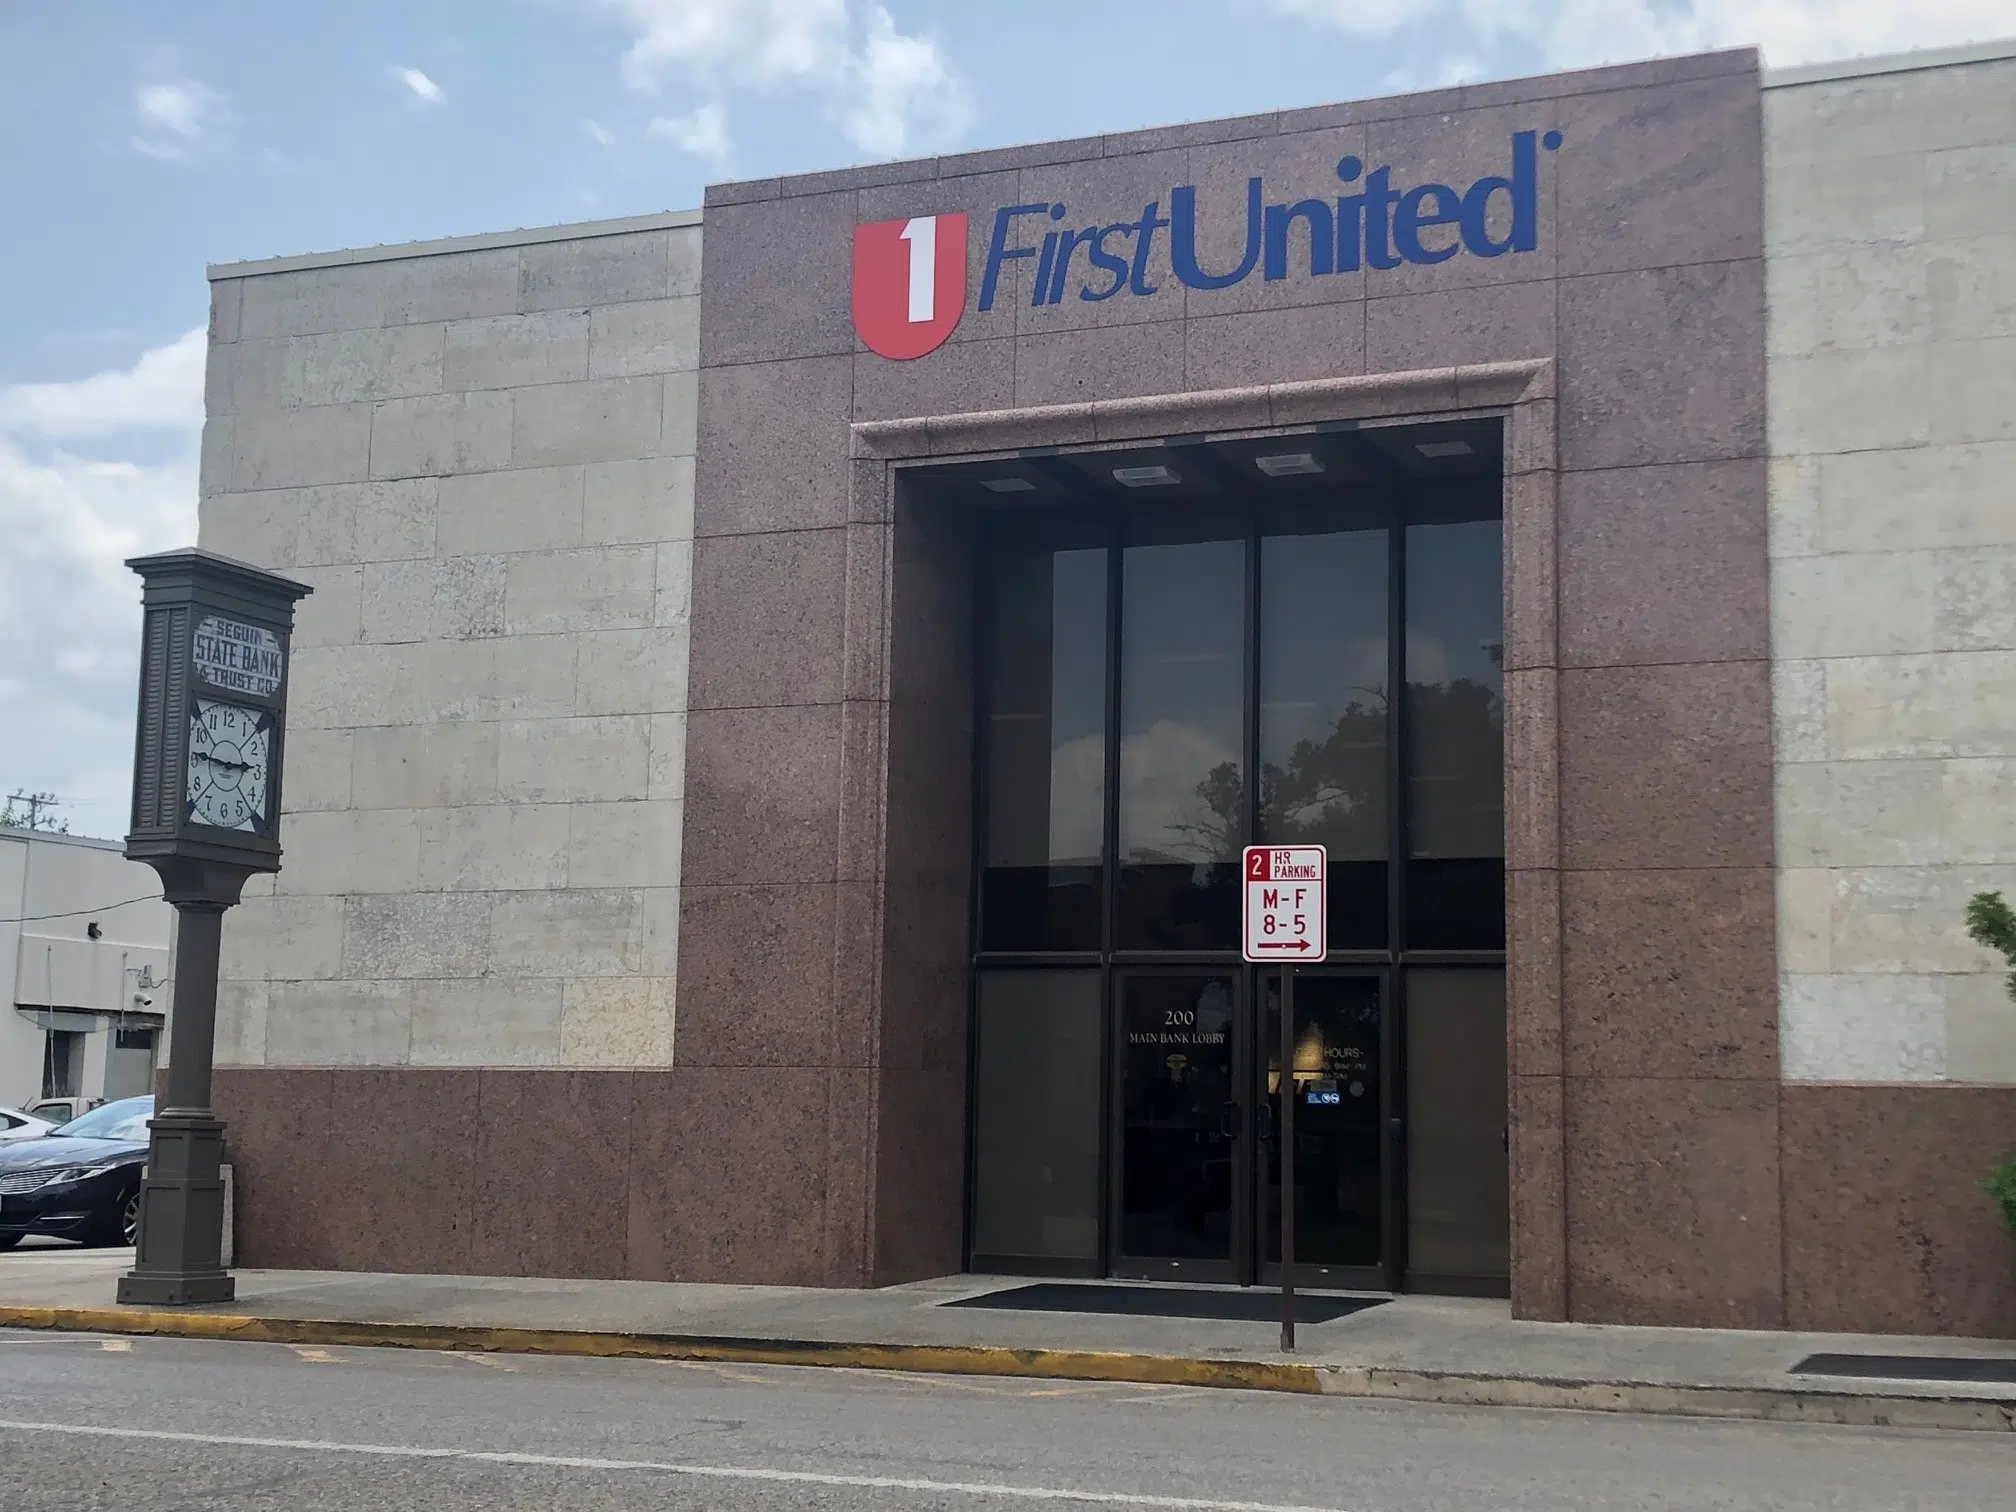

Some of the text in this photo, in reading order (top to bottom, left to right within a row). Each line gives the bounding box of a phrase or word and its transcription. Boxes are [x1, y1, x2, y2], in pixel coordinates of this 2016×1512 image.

[217, 620, 262, 645] SEGUIN
[196, 634, 282, 679] STATE BANK
[213, 667, 253, 691] TRUST
[209, 713, 217, 730] 11
[223, 711, 235, 728] 12
[195, 727, 208, 744] 10
[250, 741, 258, 756] 2
[191, 752, 198, 768] 9
[253, 764, 261, 780] 3
[193, 776, 200, 791] 8
[247, 786, 256, 802] 4
[205, 795, 212, 811] 7
[220, 803, 228, 819] 6
[235, 800, 243, 817] 5
[1251, 854, 1263, 875] 2
[1274, 851, 1291, 865] HR
[1274, 865, 1316, 878] PARKING
[1164, 1010, 1194, 1026] 200
[1129, 1032, 1226, 1045] MAIN BANK LOBBY
